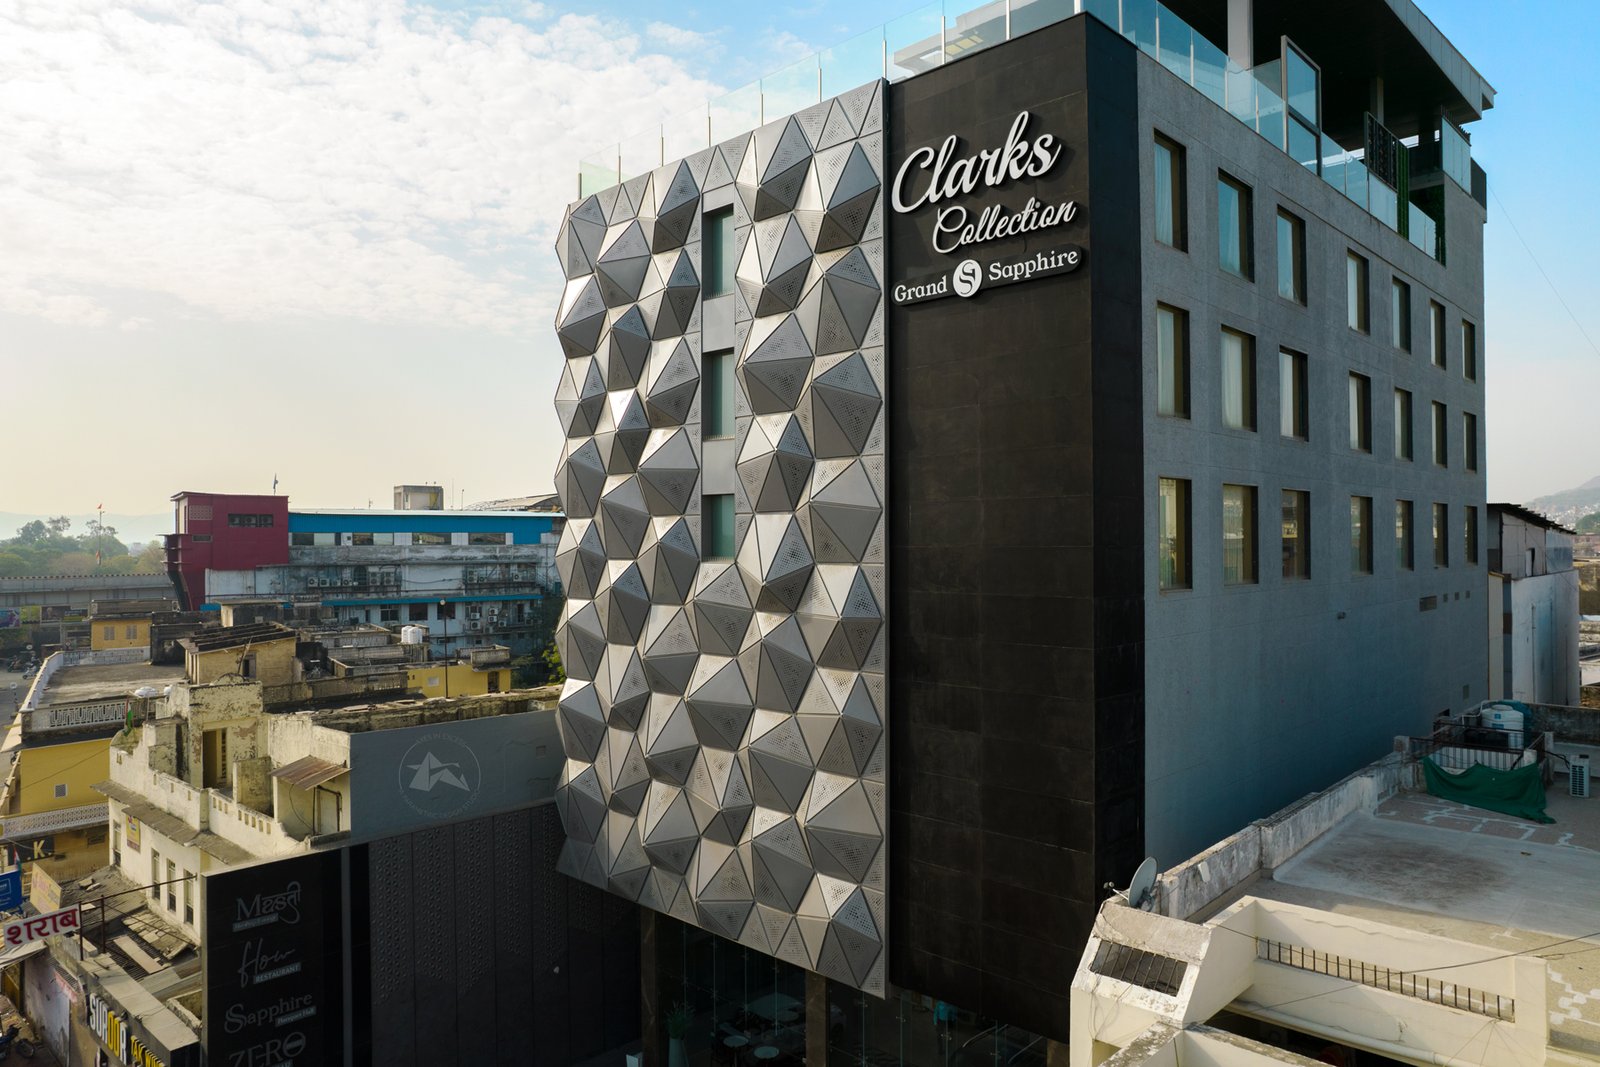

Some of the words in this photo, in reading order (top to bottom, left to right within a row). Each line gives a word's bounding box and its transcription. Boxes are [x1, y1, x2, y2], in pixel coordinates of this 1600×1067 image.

[891, 110, 1062, 214] Clarks
[932, 197, 1077, 254] Collection
[894, 276, 947, 303] Grand
[988, 250, 1079, 281] Sapphire
[6, 907, 79, 946] शराब
[89, 993, 127, 1066] SUROOR
[224, 993, 313, 1034] Sapphire
